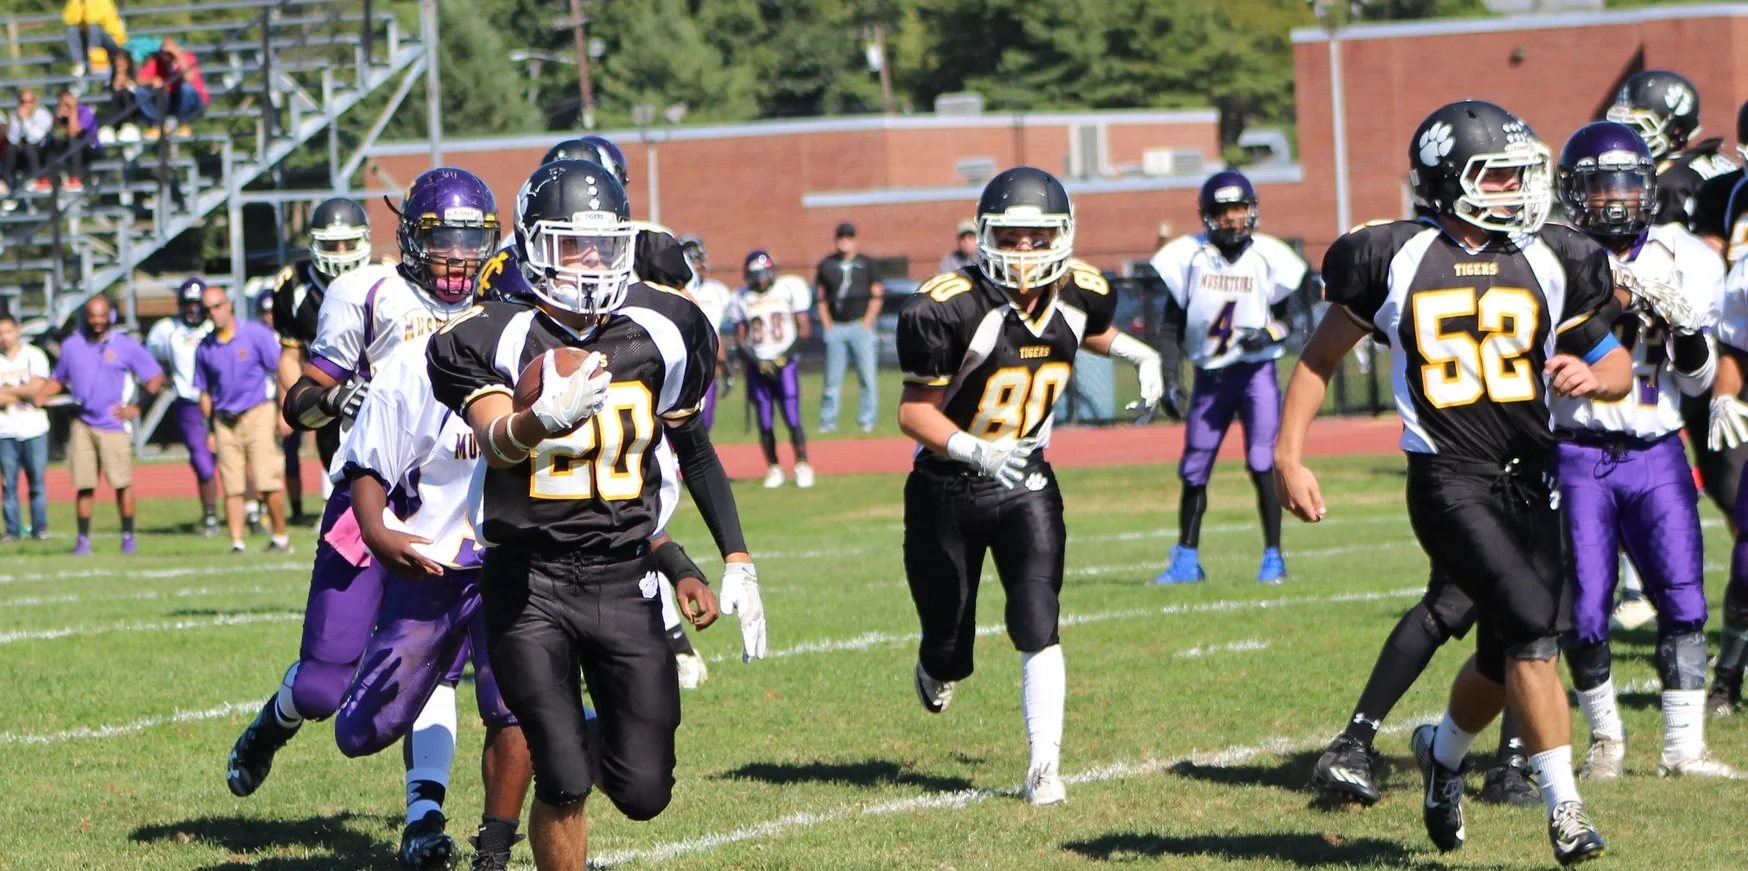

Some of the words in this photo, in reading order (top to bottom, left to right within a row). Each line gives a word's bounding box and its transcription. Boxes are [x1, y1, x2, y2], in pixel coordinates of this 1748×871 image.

[584, 213, 604, 221] TIGERS
[1453, 261, 1500, 277] TIGERS
[1019, 344, 1051, 360] TIGERS
[1207, 299, 1238, 358] 4
[1412, 286, 1540, 410] 52
[967, 361, 1072, 441] 80
[529, 379, 655, 502] 20
